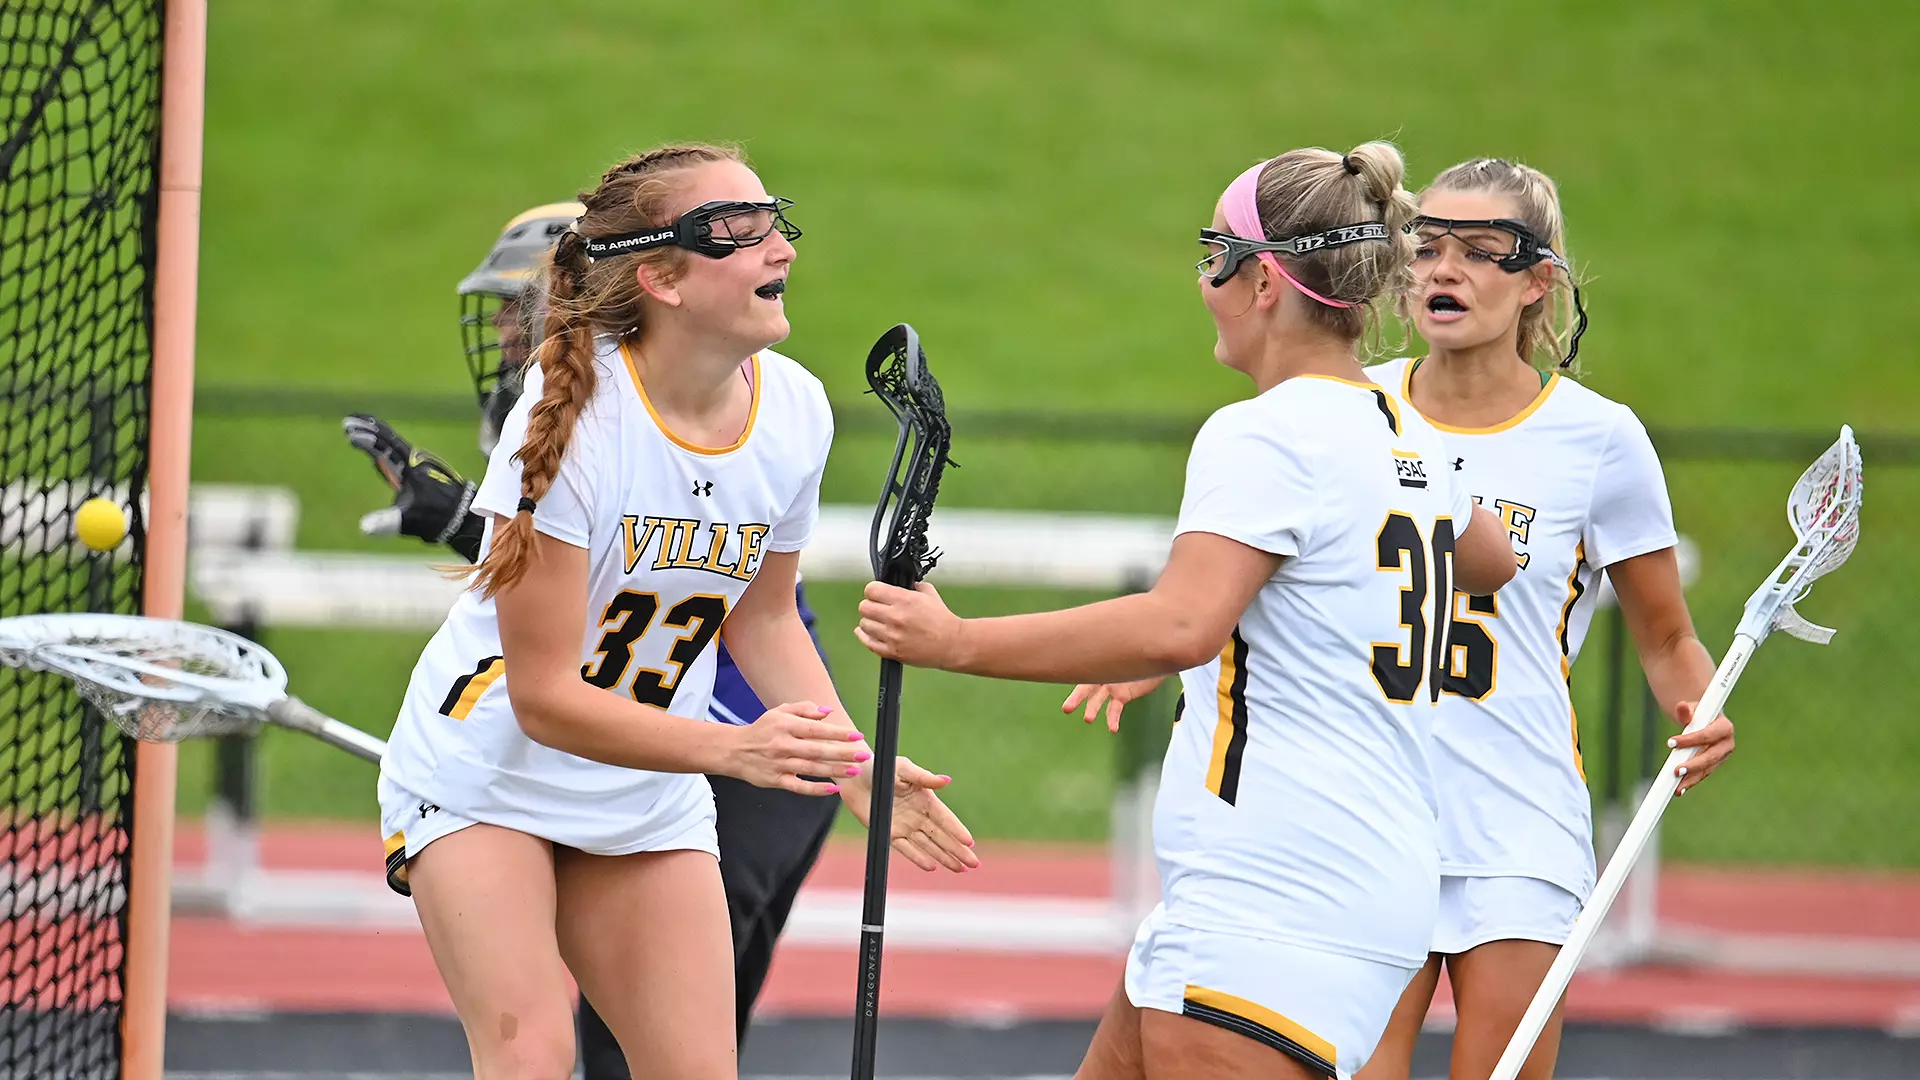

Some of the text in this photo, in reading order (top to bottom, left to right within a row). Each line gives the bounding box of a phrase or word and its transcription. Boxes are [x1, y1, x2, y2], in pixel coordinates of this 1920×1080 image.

[608, 231, 674, 250] ARMOUR
[1394, 458, 1427, 478] PSAC
[620, 514, 770, 582] VILLE
[580, 588, 730, 711] 33
[865, 937, 877, 1017] DRAGONFLY
